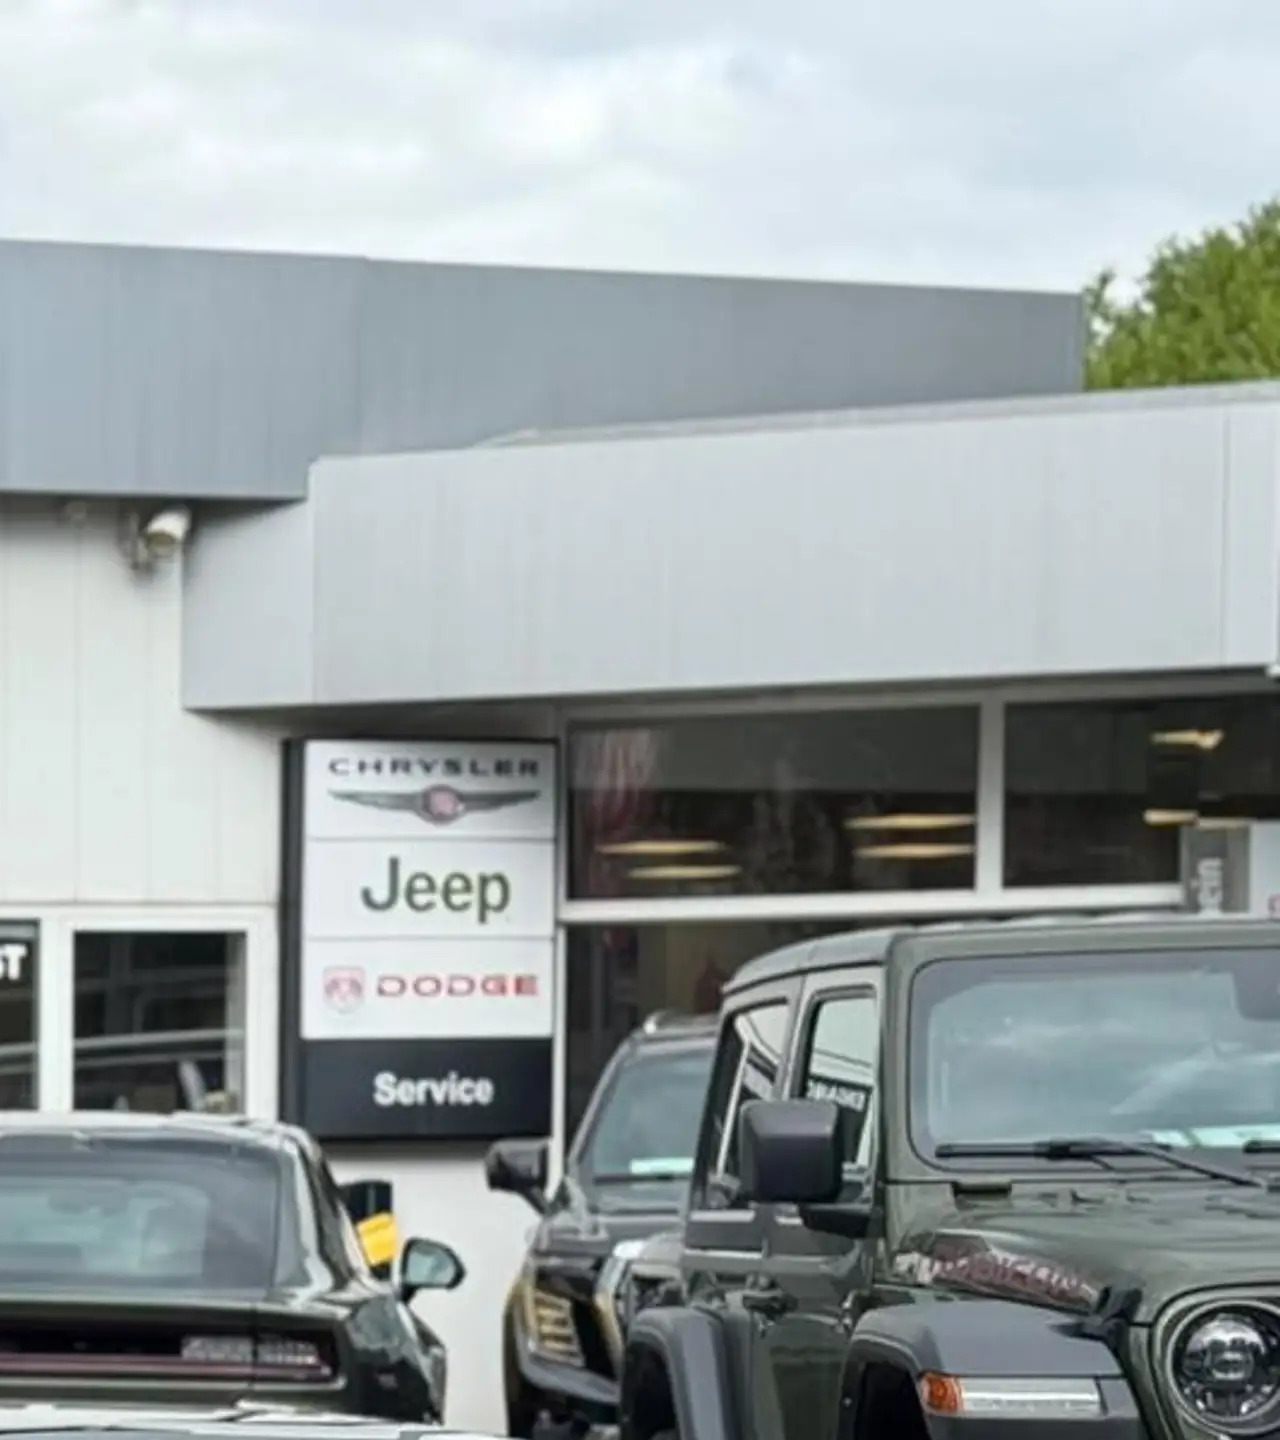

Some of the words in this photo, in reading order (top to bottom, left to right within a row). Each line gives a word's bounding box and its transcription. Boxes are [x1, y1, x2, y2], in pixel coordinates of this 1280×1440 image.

[327, 757, 539, 777] CHRYSLER
[361, 855, 510, 924] Jeep
[376, 974, 540, 997] DODGE
[372, 1072, 495, 1106] Service
